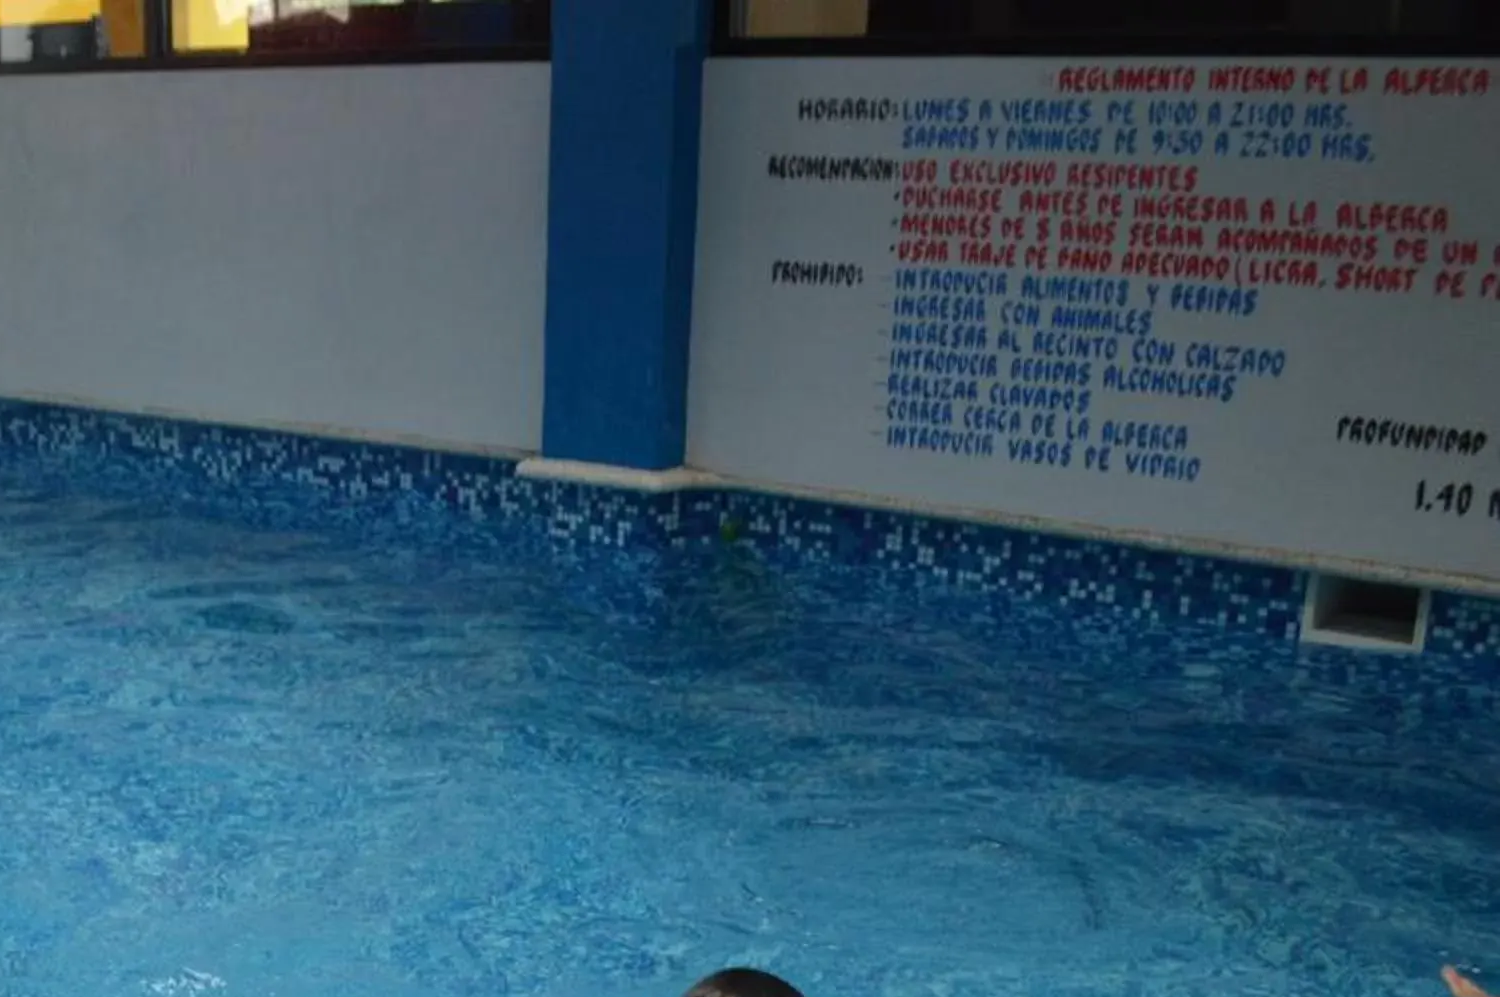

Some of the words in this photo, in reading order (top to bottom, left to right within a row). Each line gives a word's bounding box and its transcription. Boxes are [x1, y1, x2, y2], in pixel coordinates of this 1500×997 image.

[1058, 66, 1195, 94] REGLAMENTO
[1208, 68, 1295, 93] INTERNO
[1305, 68, 1331, 93] DE
[1340, 69, 1367, 93] LA
[1384, 69, 1490, 96] ALBERCA
[902, 98, 970, 124] LUNES
[979, 99, 991, 123] A
[1000, 99, 1091, 125] VIERNES
[1108, 100, 1136, 126] DE
[1148, 102, 1197, 126] 10:00
[1207, 102, 1220, 126] A
[1230, 102, 1295, 127] 21:00
[1304, 104, 1353, 129] HRS.
[902, 126, 979, 151] SABADOS
[986, 128, 996, 148] Y
[1005, 127, 1100, 153] DOMINGOS
[1114, 128, 1140, 154] DE
[1215, 132, 1229, 155] A
[1240, 132, 1312, 158] 22:00
[1321, 132, 1376, 164] HRS.
[902, 160, 937, 184] USO
[949, 160, 1057, 187] EXCLUSIVO
[1066, 162, 1199, 193] RESIDENTES
[902, 187, 1002, 211] DUCHARSE
[1019, 190, 1087, 215] ANTES
[1097, 194, 1124, 217] DE
[1134, 196, 1248, 222] INGRESAR
[1260, 199, 1275, 222] A
[1289, 202, 1317, 227] LA
[1337, 204, 1449, 233] ALBERCA
[901, 216, 991, 239] MENORES
[1001, 219, 1025, 240] DE
[1129, 223, 1203, 248] SERAN
[1394, 238, 1429, 263] DE
[1442, 243, 1478, 265] UN
[772, 260, 864, 288] PROHIBIDO:
[898, 240, 949, 262] USAR
[960, 243, 1015, 266] TRAJE
[1025, 246, 1050, 268] DE
[1122, 252, 1229, 281] ADECUADO
[1335, 262, 1419, 293] SHORT
[1435, 273, 1466, 298] DE
[895, 268, 1008, 296] INTRODUCIR
[1021, 272, 1130, 306] ALIMENTOS
[1147, 284, 1159, 303] Y
[1171, 284, 1259, 315] BEBIDAS
[894, 295, 986, 322] INGRESAR
[1000, 300, 1039, 327] CON
[1051, 305, 1152, 337] ANIMALES
[892, 323, 987, 349] INGRESAR
[997, 330, 1021, 352] AL
[1033, 332, 1117, 359] RECINTO
[1133, 338, 1175, 366] CON
[1186, 342, 1286, 377] CALZADO
[888, 374, 979, 401] REALIZAR
[989, 382, 1091, 413] CLAVADOS
[890, 348, 997, 377] INTRODUCIR
[1011, 356, 1091, 386] BEBIDAS
[1103, 364, 1237, 402] ALCOHOLICAS
[886, 400, 952, 424] CORRER
[964, 405, 1021, 432] CERCA
[1031, 412, 1055, 437] DE
[1066, 416, 1089, 440] LA
[1102, 418, 1188, 450] ALBERCA
[1337, 416, 1488, 455] PROFUNDIDAD
[887, 425, 993, 456] INTRODUCIR
[1008, 438, 1072, 466] VASOS
[1085, 445, 1110, 470] DE
[1125, 452, 1201, 483] VIDRIO
[1415, 479, 1473, 515] 1.40
